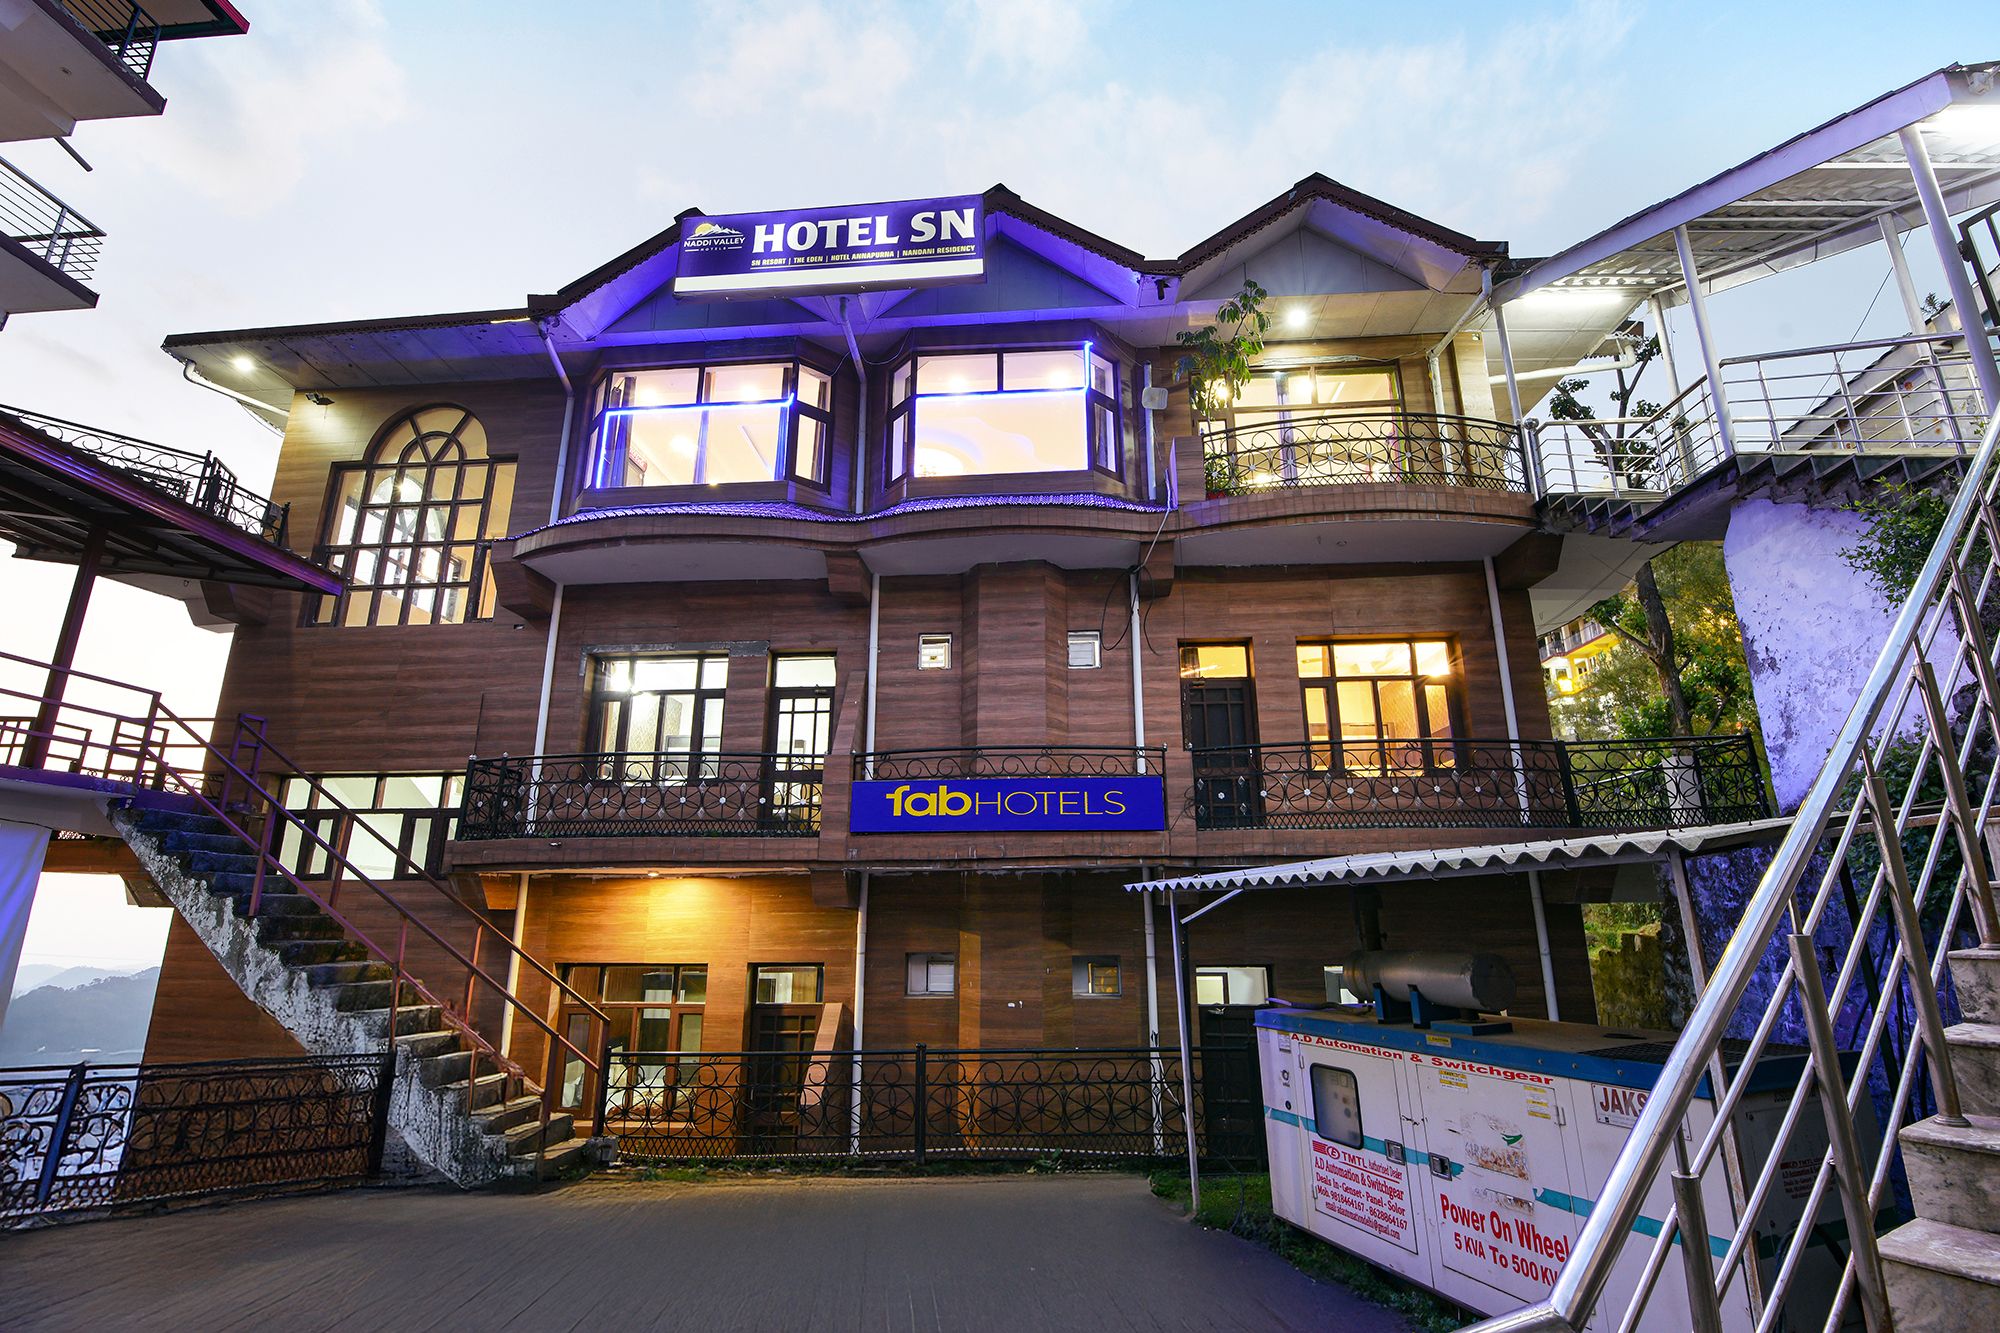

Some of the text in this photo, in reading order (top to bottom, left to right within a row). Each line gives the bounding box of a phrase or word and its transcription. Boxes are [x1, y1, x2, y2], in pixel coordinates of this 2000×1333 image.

[683, 236, 746, 247] NADDI VALLEY
[752, 207, 976, 254] HOTEL SN
[751, 259, 761, 267] SN
[761, 258, 787, 266] RESORT
[793, 256, 805, 264] THE
[851, 250, 895, 260] ANNAPURNA
[936, 245, 976, 254] RESIDENCY
[1291, 1033, 1312, 1043] A.D
[1315, 1037, 1403, 1061] Automation
[1410, 1053, 1423, 1063] &
[1431, 1057, 1554, 1085] Switchgear
[1316, 1172, 1331, 1187] Deals
[1325, 1160, 1360, 1184] Automation
[1360, 1173, 1367, 1187] &
[1366, 1175, 1405, 1201] Switchgear
[1341, 1151, 1368, 1169] TMTL
[1440, 1193, 1570, 1263] Power On Wheel
[1454, 1232, 1558, 1287] 5 KVA To 500 KV
